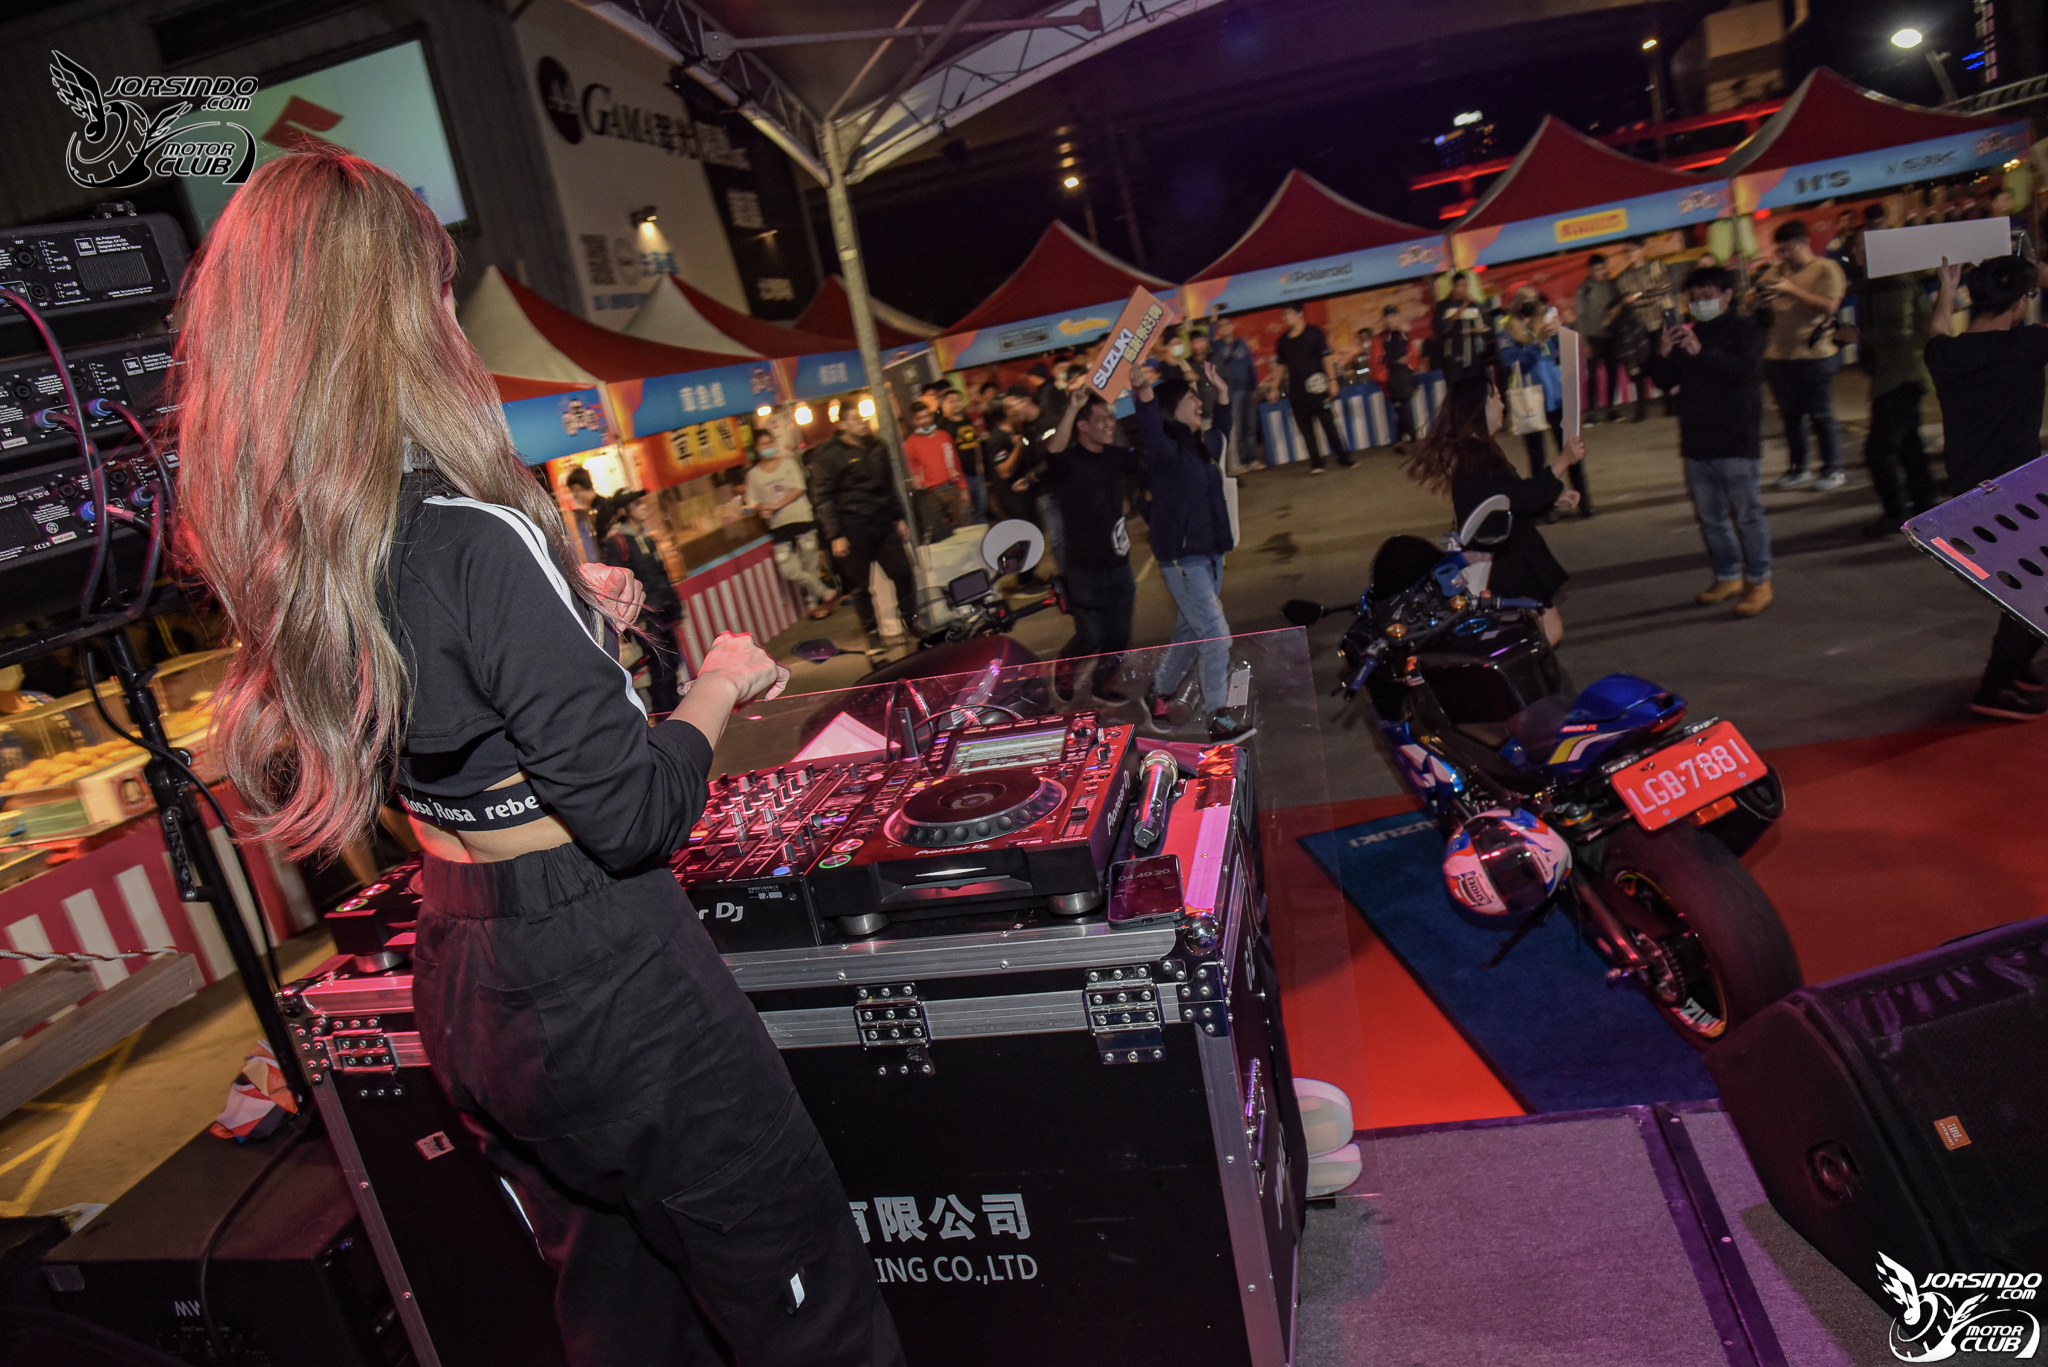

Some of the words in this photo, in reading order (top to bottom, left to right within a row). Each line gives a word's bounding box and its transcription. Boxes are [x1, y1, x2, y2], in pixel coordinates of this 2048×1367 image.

[1093, 328, 1134, 389] SUZUKI
[436, 802, 476, 822] Rosa
[484, 795, 540, 820] rebe
[1348, 820, 1439, 848] UZUKI
[1466, 875, 1487, 904] SHOEI
[1947, 1123, 1962, 1142] JBL
[877, 1257, 928, 1283] ING
[933, 1254, 1038, 1286] CO.,LTD
